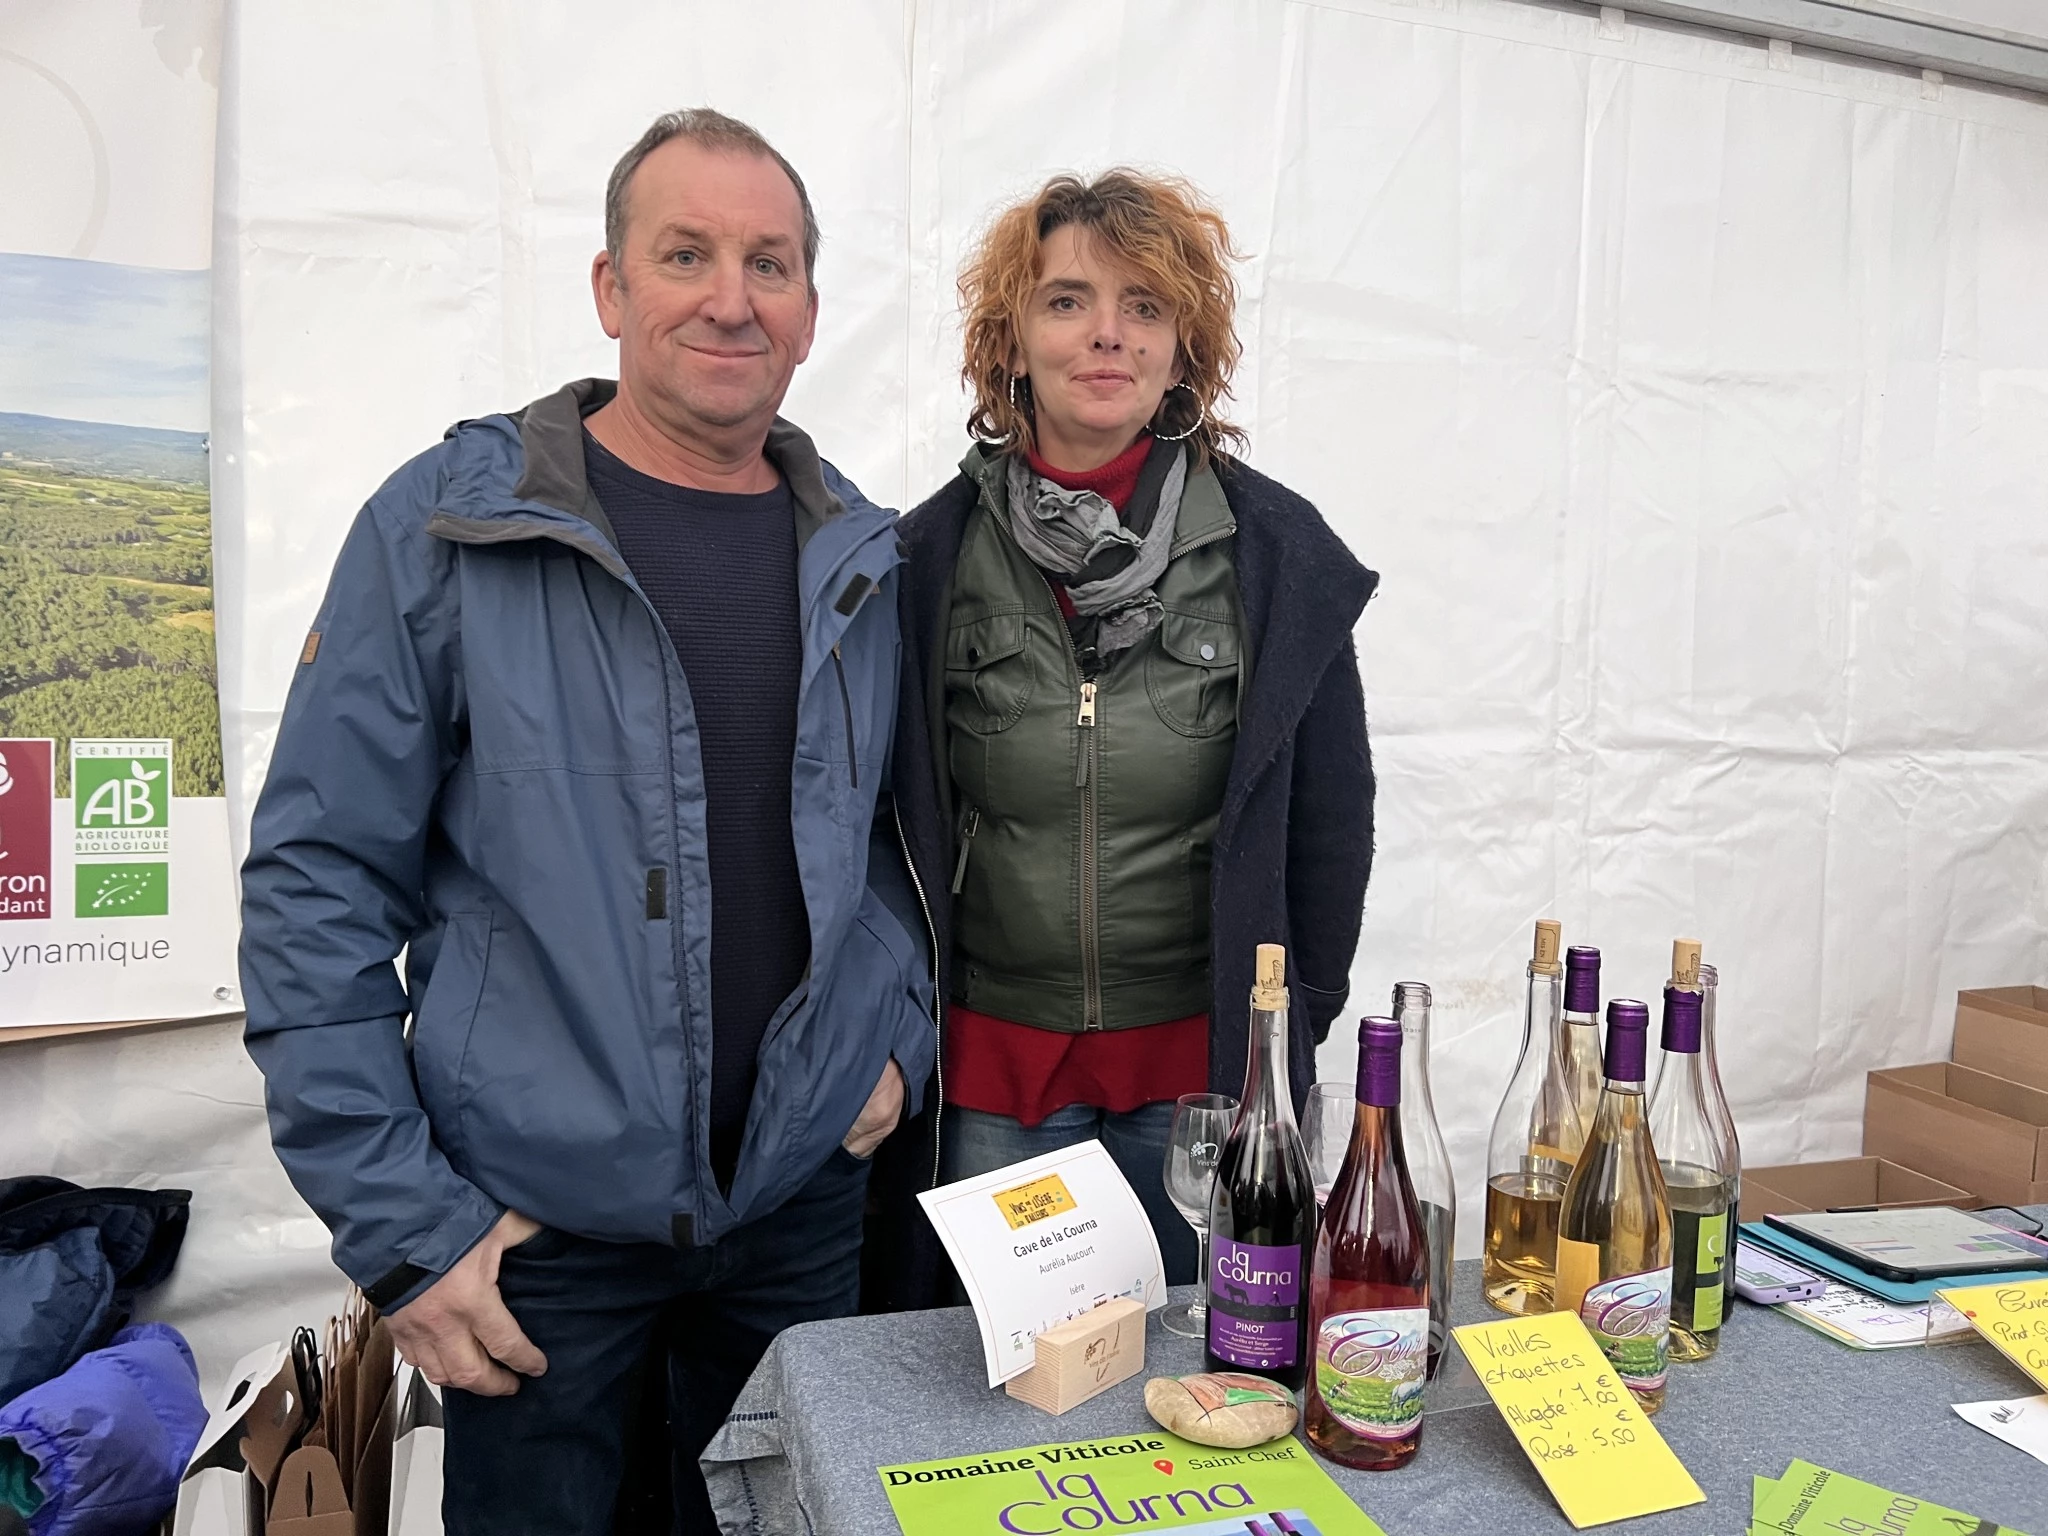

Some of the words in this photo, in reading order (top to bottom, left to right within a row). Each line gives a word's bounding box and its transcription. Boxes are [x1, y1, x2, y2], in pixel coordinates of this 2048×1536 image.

[81, 778, 155, 826] AB
[74, 830, 169, 840] AGRICULTURE
[75, 841, 169, 852] BIOLOGIQUE
[1013, 1241, 1039, 1258] Cave
[1039, 1235, 1053, 1248] de
[1051, 1231, 1064, 1243] la
[1063, 1219, 1098, 1239] Courna
[1039, 1257, 1066, 1275] Aurélia
[1066, 1245, 1096, 1264] Aucourt
[1232, 1243, 1250, 1267] la
[1217, 1256, 1292, 1286] Courna
[1069, 1283, 1085, 1295] Isère
[1235, 1321, 1265, 1334] PINOT
[1592, 1427, 1636, 1448] 5,50
[884, 1458, 1036, 1487] Domaine
[1037, 1439, 1166, 1464] Viticole
[1187, 1453, 1246, 1471] Saint
[1247, 1447, 1298, 1465] Chef
[998, 1483, 1256, 1536] Courna
[1778, 1498, 1813, 1531] Domaine
[1800, 1470, 1832, 1499] Viticole
